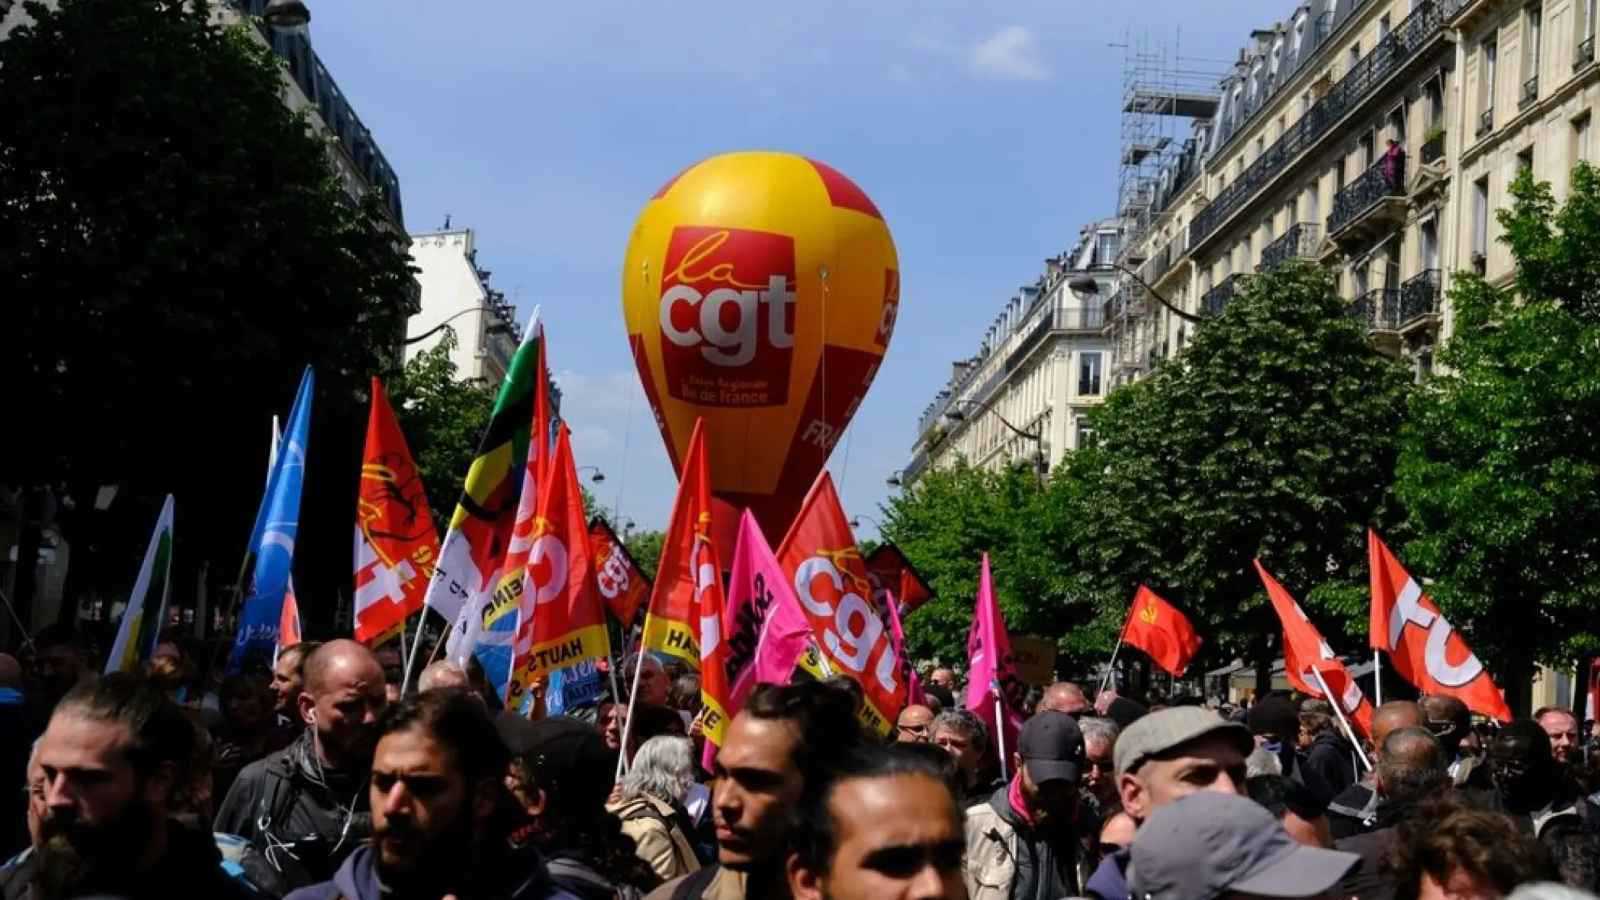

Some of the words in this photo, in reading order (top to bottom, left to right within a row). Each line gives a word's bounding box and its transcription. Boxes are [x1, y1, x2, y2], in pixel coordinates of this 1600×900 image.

[664, 231, 770, 287] la
[659, 275, 796, 367] cgt
[719, 389, 768, 404] France
